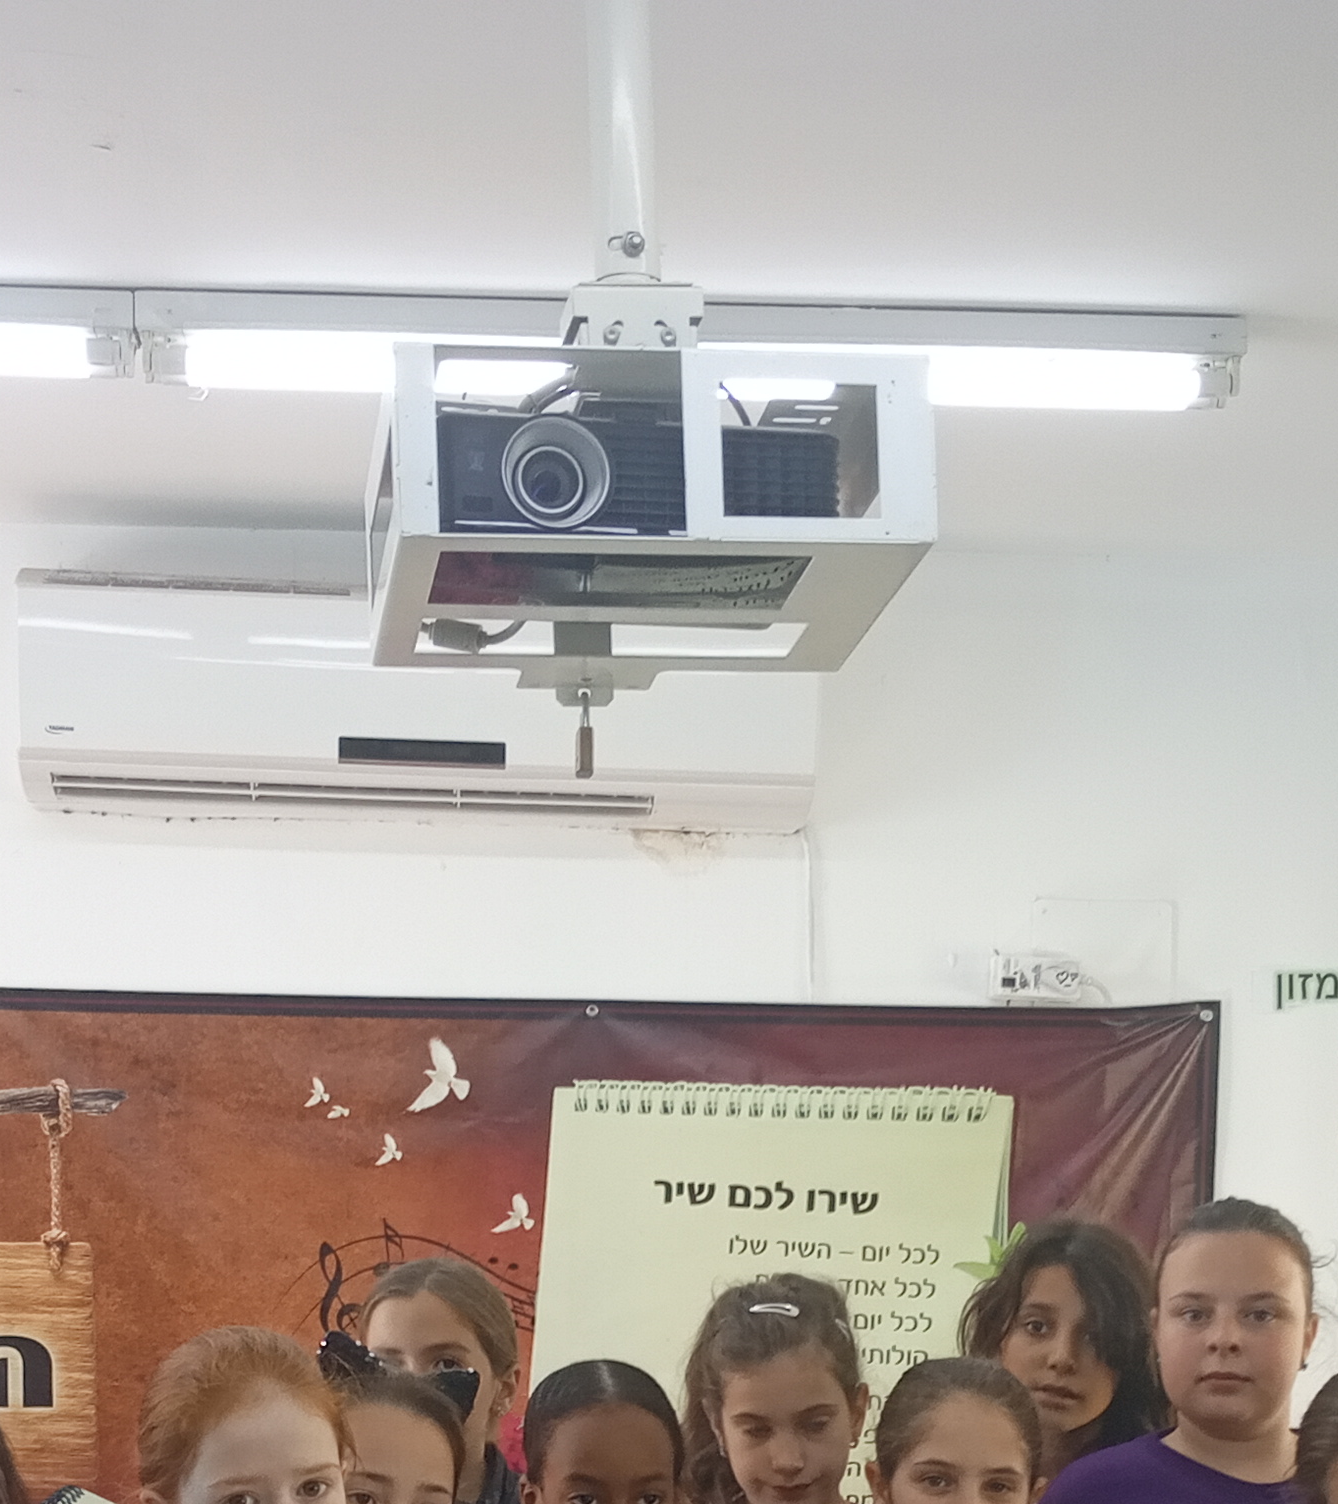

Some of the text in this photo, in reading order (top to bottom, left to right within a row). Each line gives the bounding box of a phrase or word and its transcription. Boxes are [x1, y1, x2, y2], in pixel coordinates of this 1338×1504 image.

[653, 1179, 880, 1215] שירו לכם שיר
[727, 1234, 768, 1256] שלו
[775, 1240, 832, 1260] השיר
[861, 1244, 891, 1263] יום
[898, 1242, 941, 1266] לכל
[838, 1276, 937, 1300] לכל אחד
[852, 1311, 933, 1333] לכל יום
